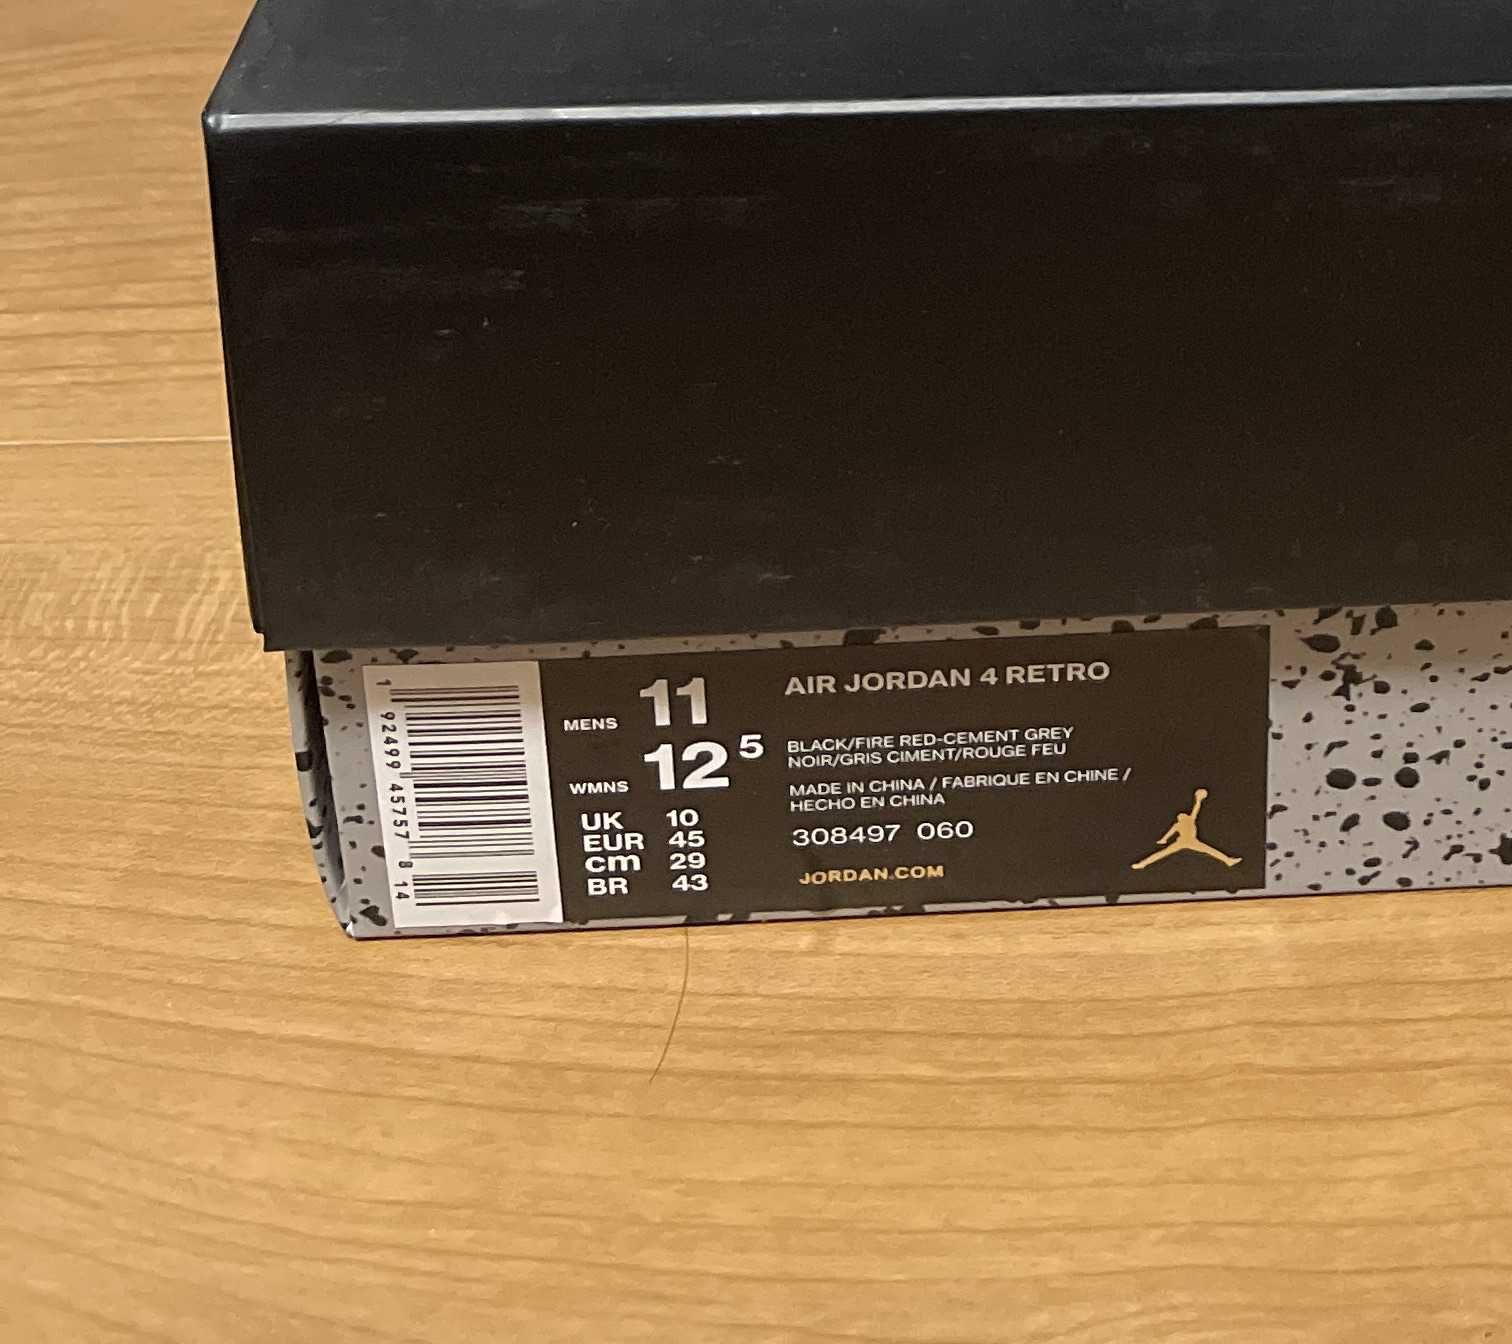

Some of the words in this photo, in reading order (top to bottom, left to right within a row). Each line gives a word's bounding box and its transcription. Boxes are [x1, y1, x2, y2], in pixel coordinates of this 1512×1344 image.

[784, 674, 836, 696] AIR
[844, 667, 972, 693] JORDAN
[979, 666, 999, 686] 4
[1005, 660, 1111, 685] RETRO
[563, 717, 618, 732] MENS
[639, 677, 708, 727] 11
[381, 711, 402, 770] 92499
[786, 735, 895, 753] BLACK/FIRE
[899, 728, 1020, 748] RED-CEMENT
[1024, 726, 1074, 741] GREY
[569, 780, 629, 795] WMNS
[643, 741, 730, 790] 12
[738, 733, 764, 759] 5
[787, 750, 882, 769] NOIR/GRIS
[886, 743, 1027, 764] CIMENT/ROUGE
[1031, 742, 1067, 756] FEU
[789, 781, 842, 797] MADE
[846, 780, 865, 794] IN
[868, 777, 926, 794] CHINA
[929, 776, 939, 792] /
[942, 771, 1031, 790] FABRIQUE
[1035, 770, 1060, 785] EN
[1063, 768, 1119, 784] CHINE
[389, 782, 411, 840] 45757
[790, 796, 856, 812] HECHO
[860, 794, 886, 809] EN
[889, 792, 946, 808] CHINA
[580, 811, 624, 831] UK
[665, 808, 700, 827] 10
[583, 832, 645, 852] EUR
[668, 830, 705, 848] 45
[792, 823, 901, 847] 308497
[916, 820, 975, 841] 060
[584, 854, 641, 873] cm
[669, 852, 706, 870] 29
[798, 864, 945, 886] JORDAN.COM
[587, 877, 629, 896] BR
[671, 873, 709, 891] 43
